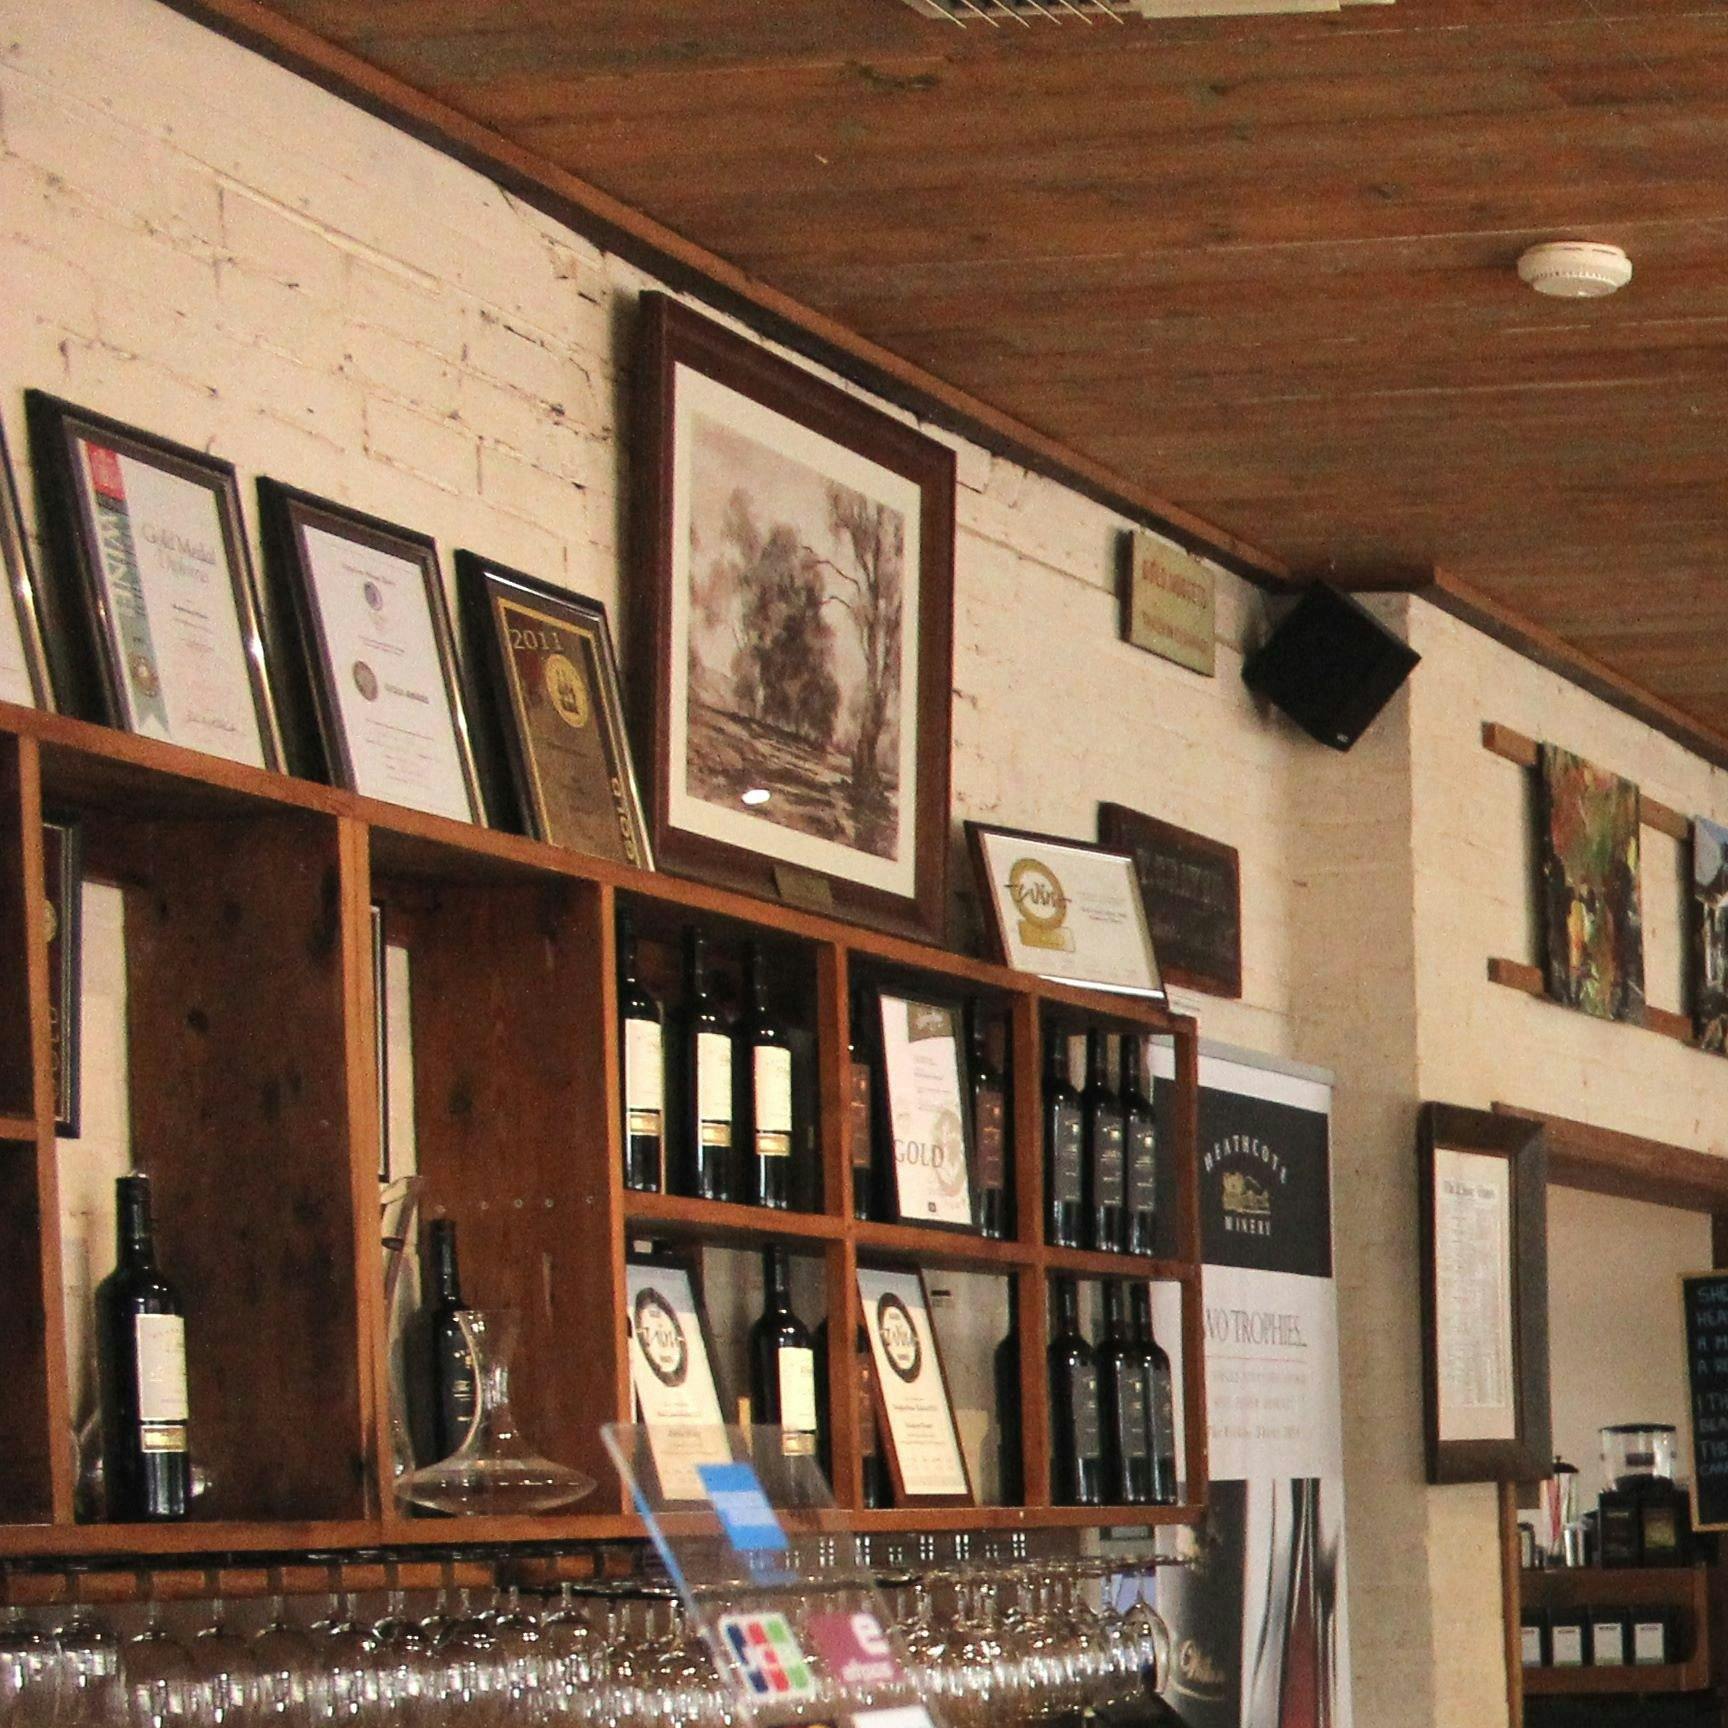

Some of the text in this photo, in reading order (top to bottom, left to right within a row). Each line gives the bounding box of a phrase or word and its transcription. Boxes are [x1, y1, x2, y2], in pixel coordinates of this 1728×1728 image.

[508, 628, 565, 650] 2011
[894, 1139, 945, 1168] GOLD
[1204, 1134, 1287, 1184] HEATHCOTE
[1224, 1216, 1271, 1236] WINERY
